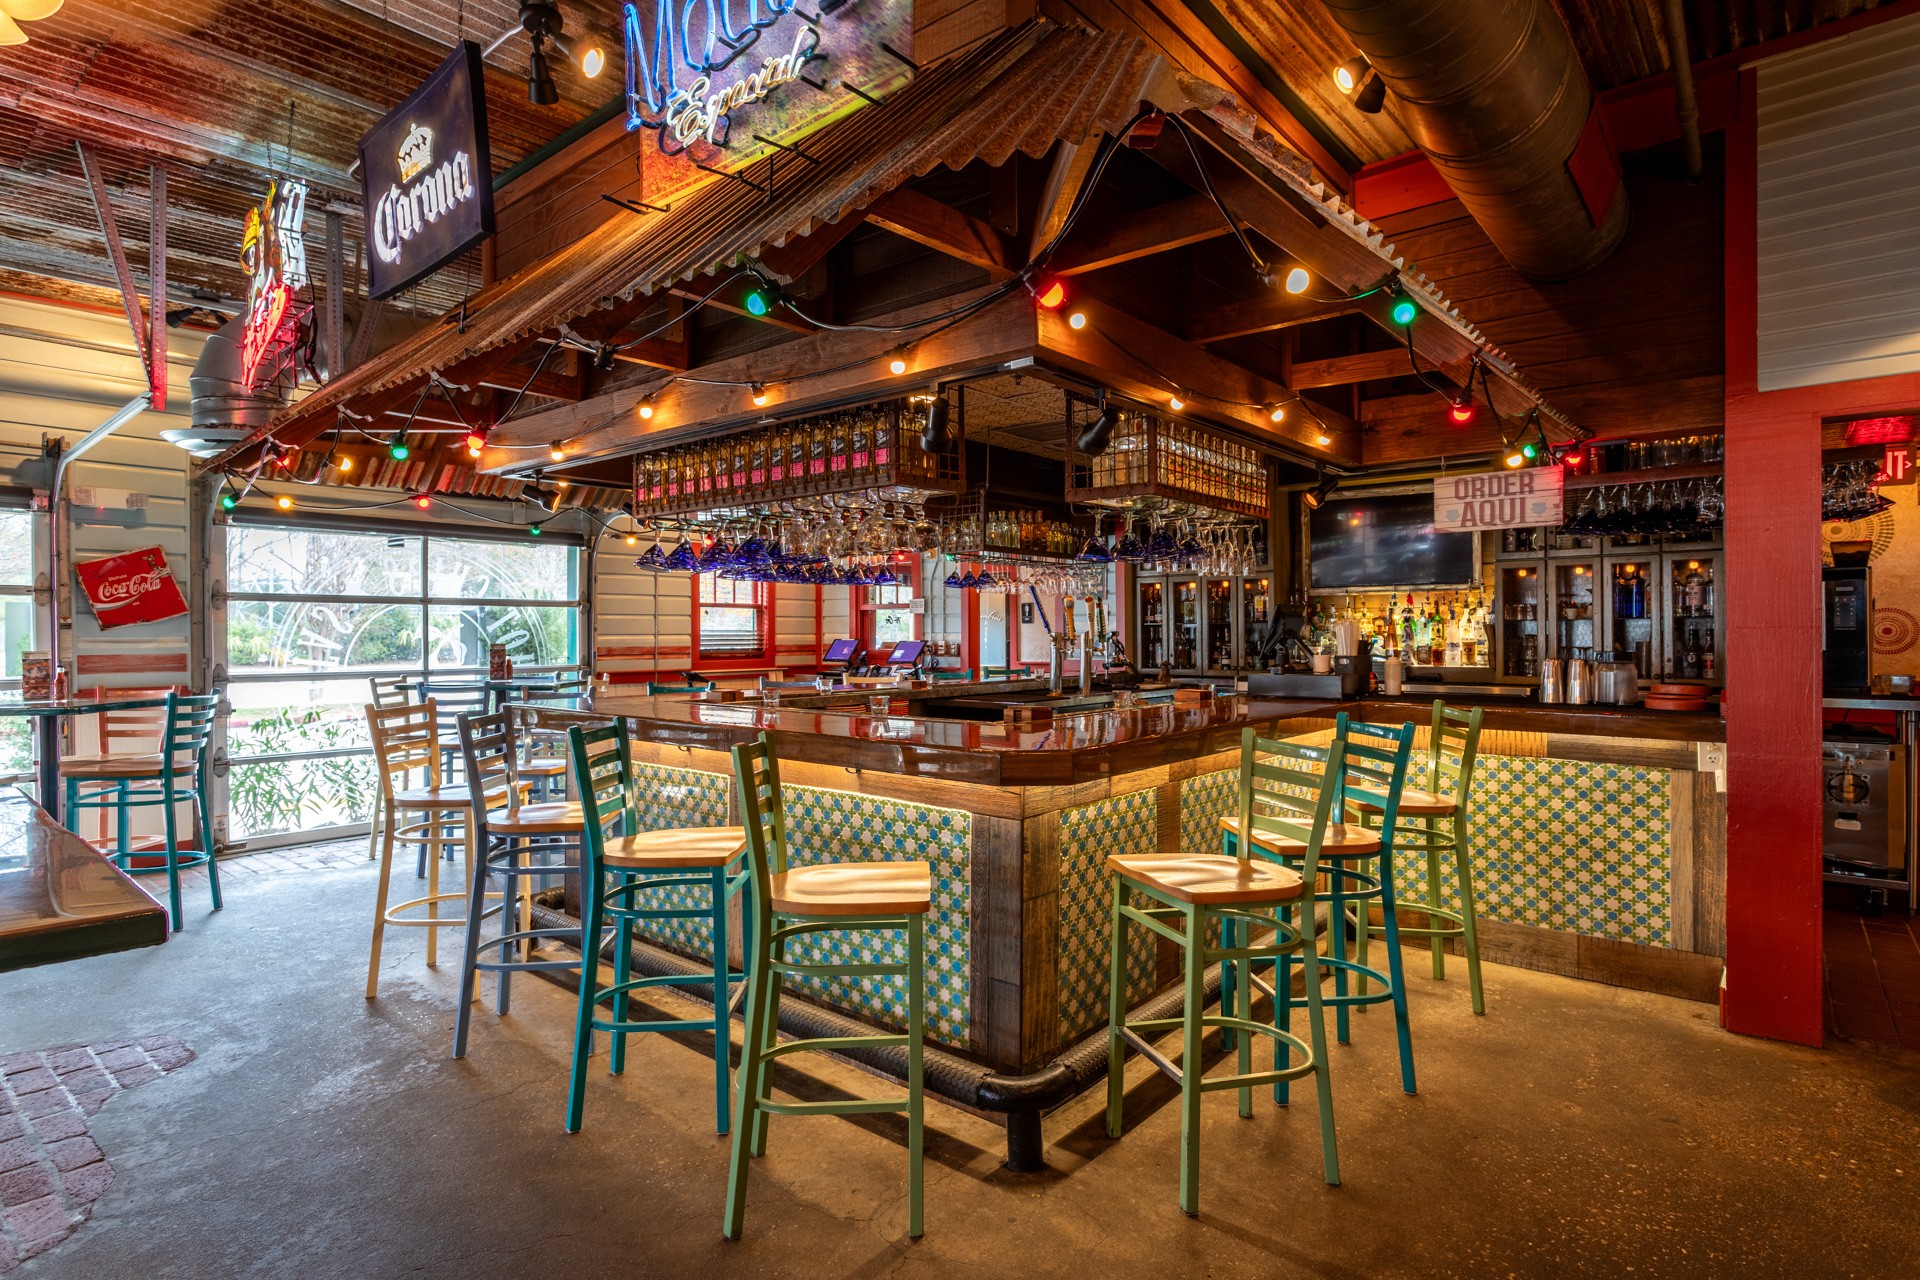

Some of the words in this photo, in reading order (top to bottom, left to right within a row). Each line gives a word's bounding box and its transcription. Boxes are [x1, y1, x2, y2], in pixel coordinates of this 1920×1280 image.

[666, 26, 808, 148] Especial
[373, 151, 476, 265] Corona
[1886, 450, 1908, 480] IT
[1454, 471, 1535, 500] ORDER
[1461, 497, 1526, 527] AQUI
